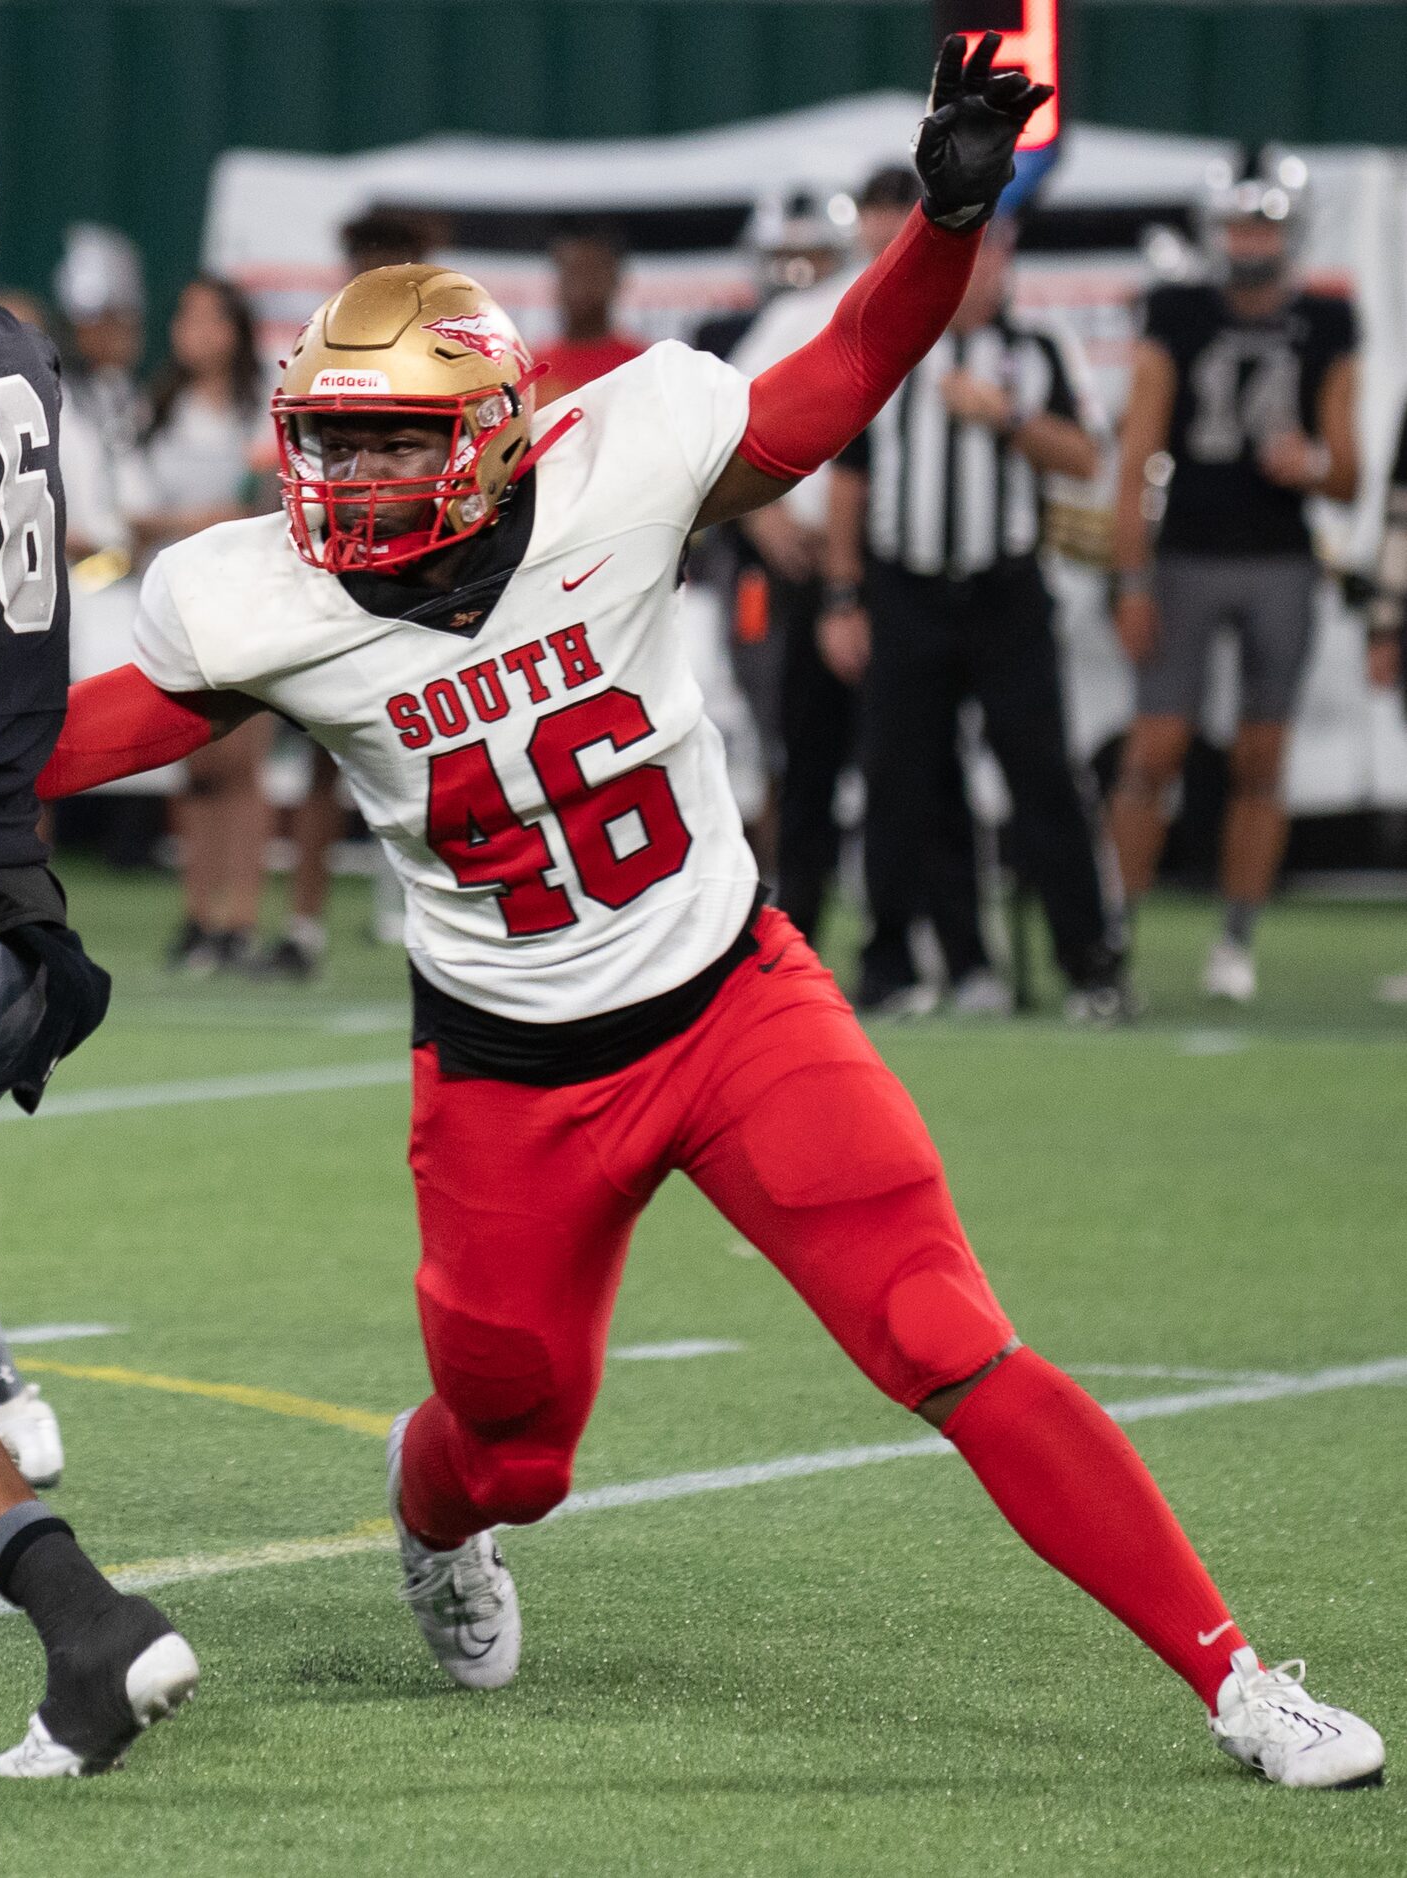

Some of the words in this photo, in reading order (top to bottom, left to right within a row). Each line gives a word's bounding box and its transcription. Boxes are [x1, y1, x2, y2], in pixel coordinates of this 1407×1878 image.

[319, 374, 380, 388] Riddell
[386, 622, 604, 750] SOUTH
[425, 686, 693, 938] 46
